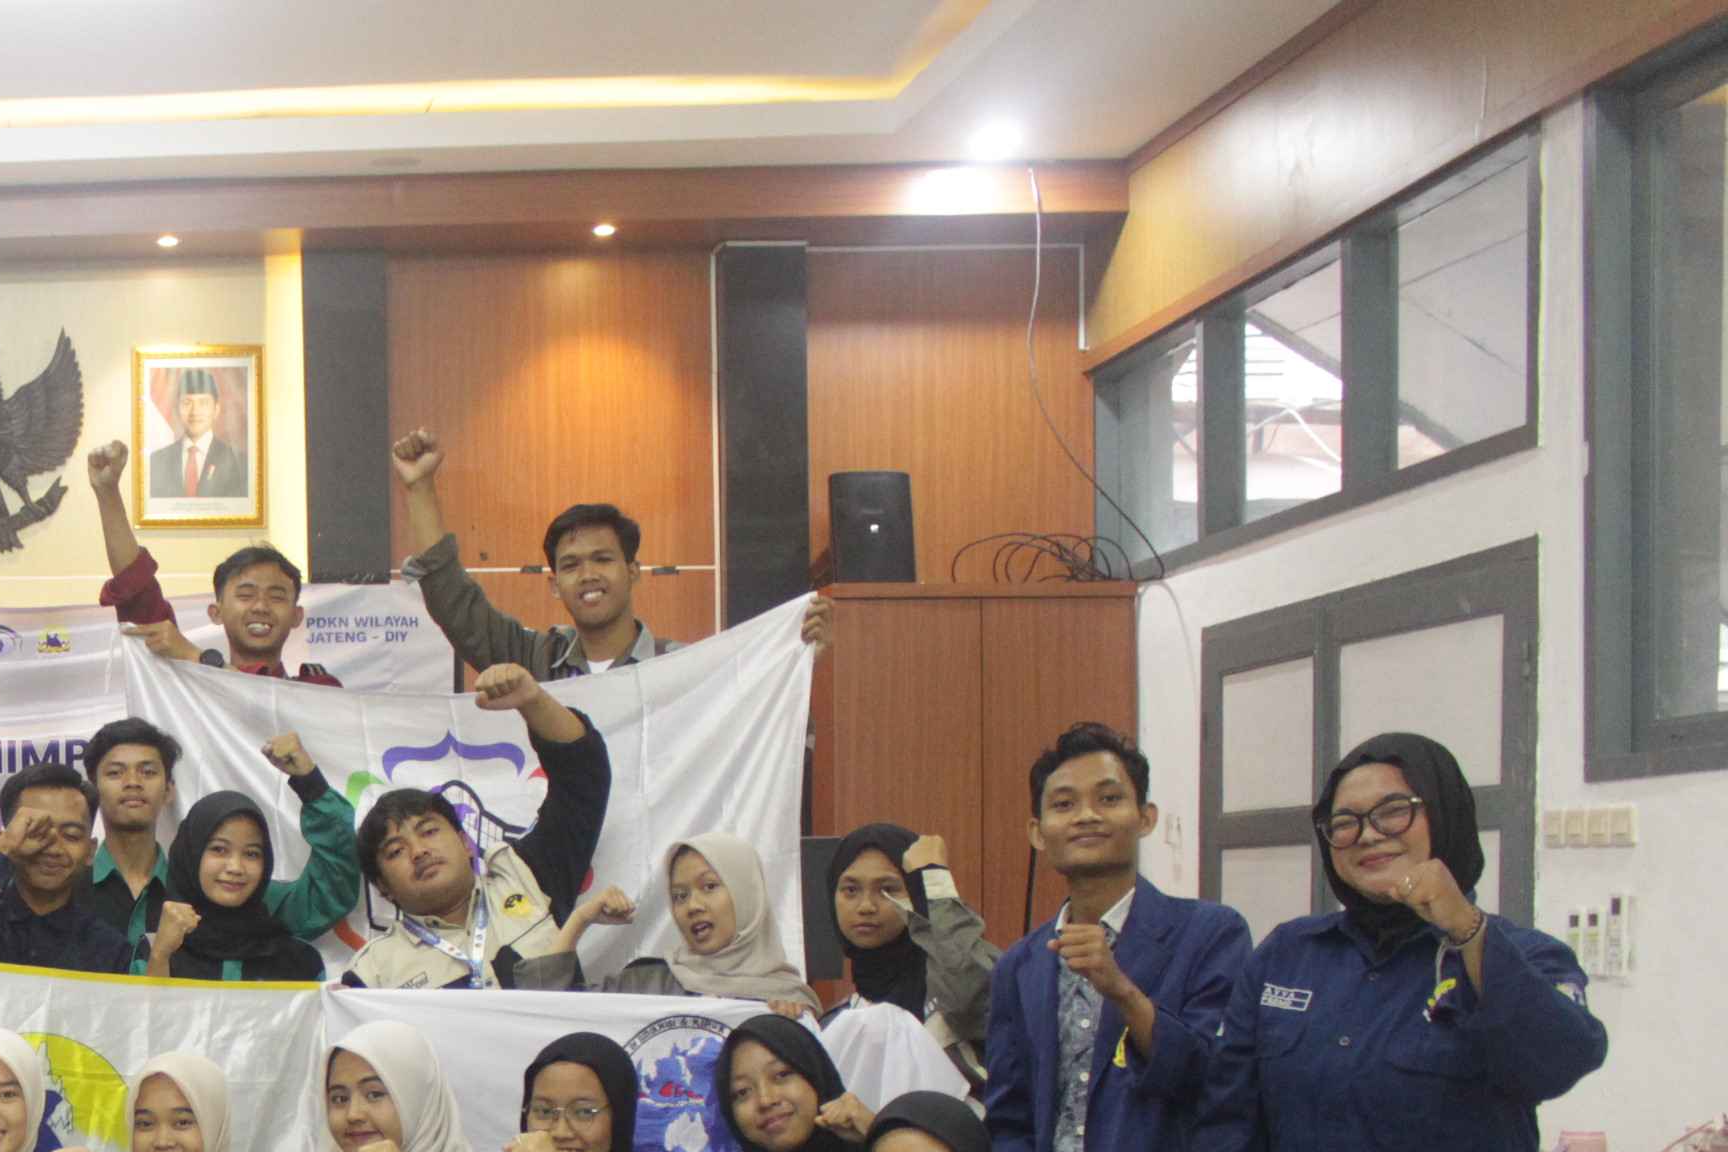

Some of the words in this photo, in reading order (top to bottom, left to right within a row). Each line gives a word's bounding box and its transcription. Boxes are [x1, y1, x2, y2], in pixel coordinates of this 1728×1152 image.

[305, 617, 349, 629] PDKN
[353, 616, 419, 628] WILAYAH
[305, 631, 367, 644] JATENG
[384, 631, 409, 643] DIY
